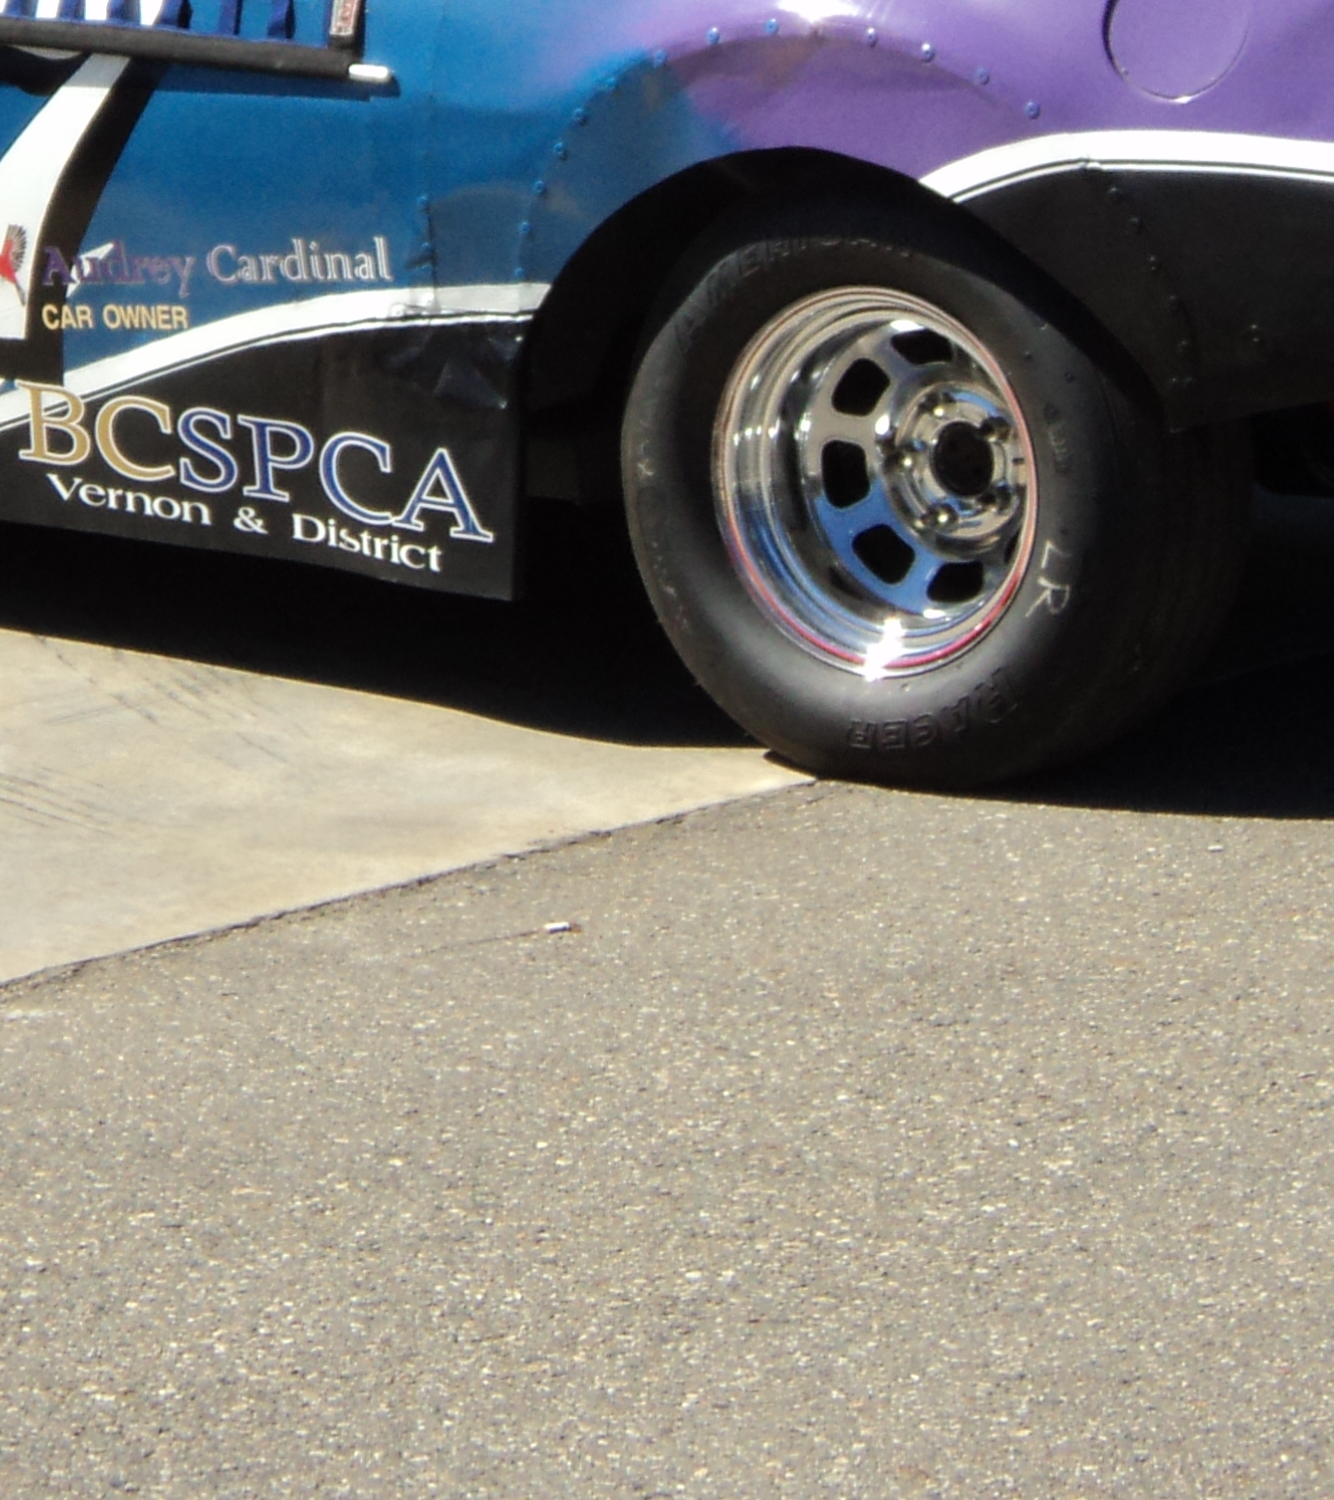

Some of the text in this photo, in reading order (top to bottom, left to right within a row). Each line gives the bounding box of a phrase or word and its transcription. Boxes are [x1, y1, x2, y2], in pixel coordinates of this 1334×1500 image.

[42, 234, 393, 299] Audrey Cardinal
[41, 303, 190, 331] CAR OWNER
[14, 378, 495, 544] BCSPCA
[45, 473, 444, 573] Vernon & District
